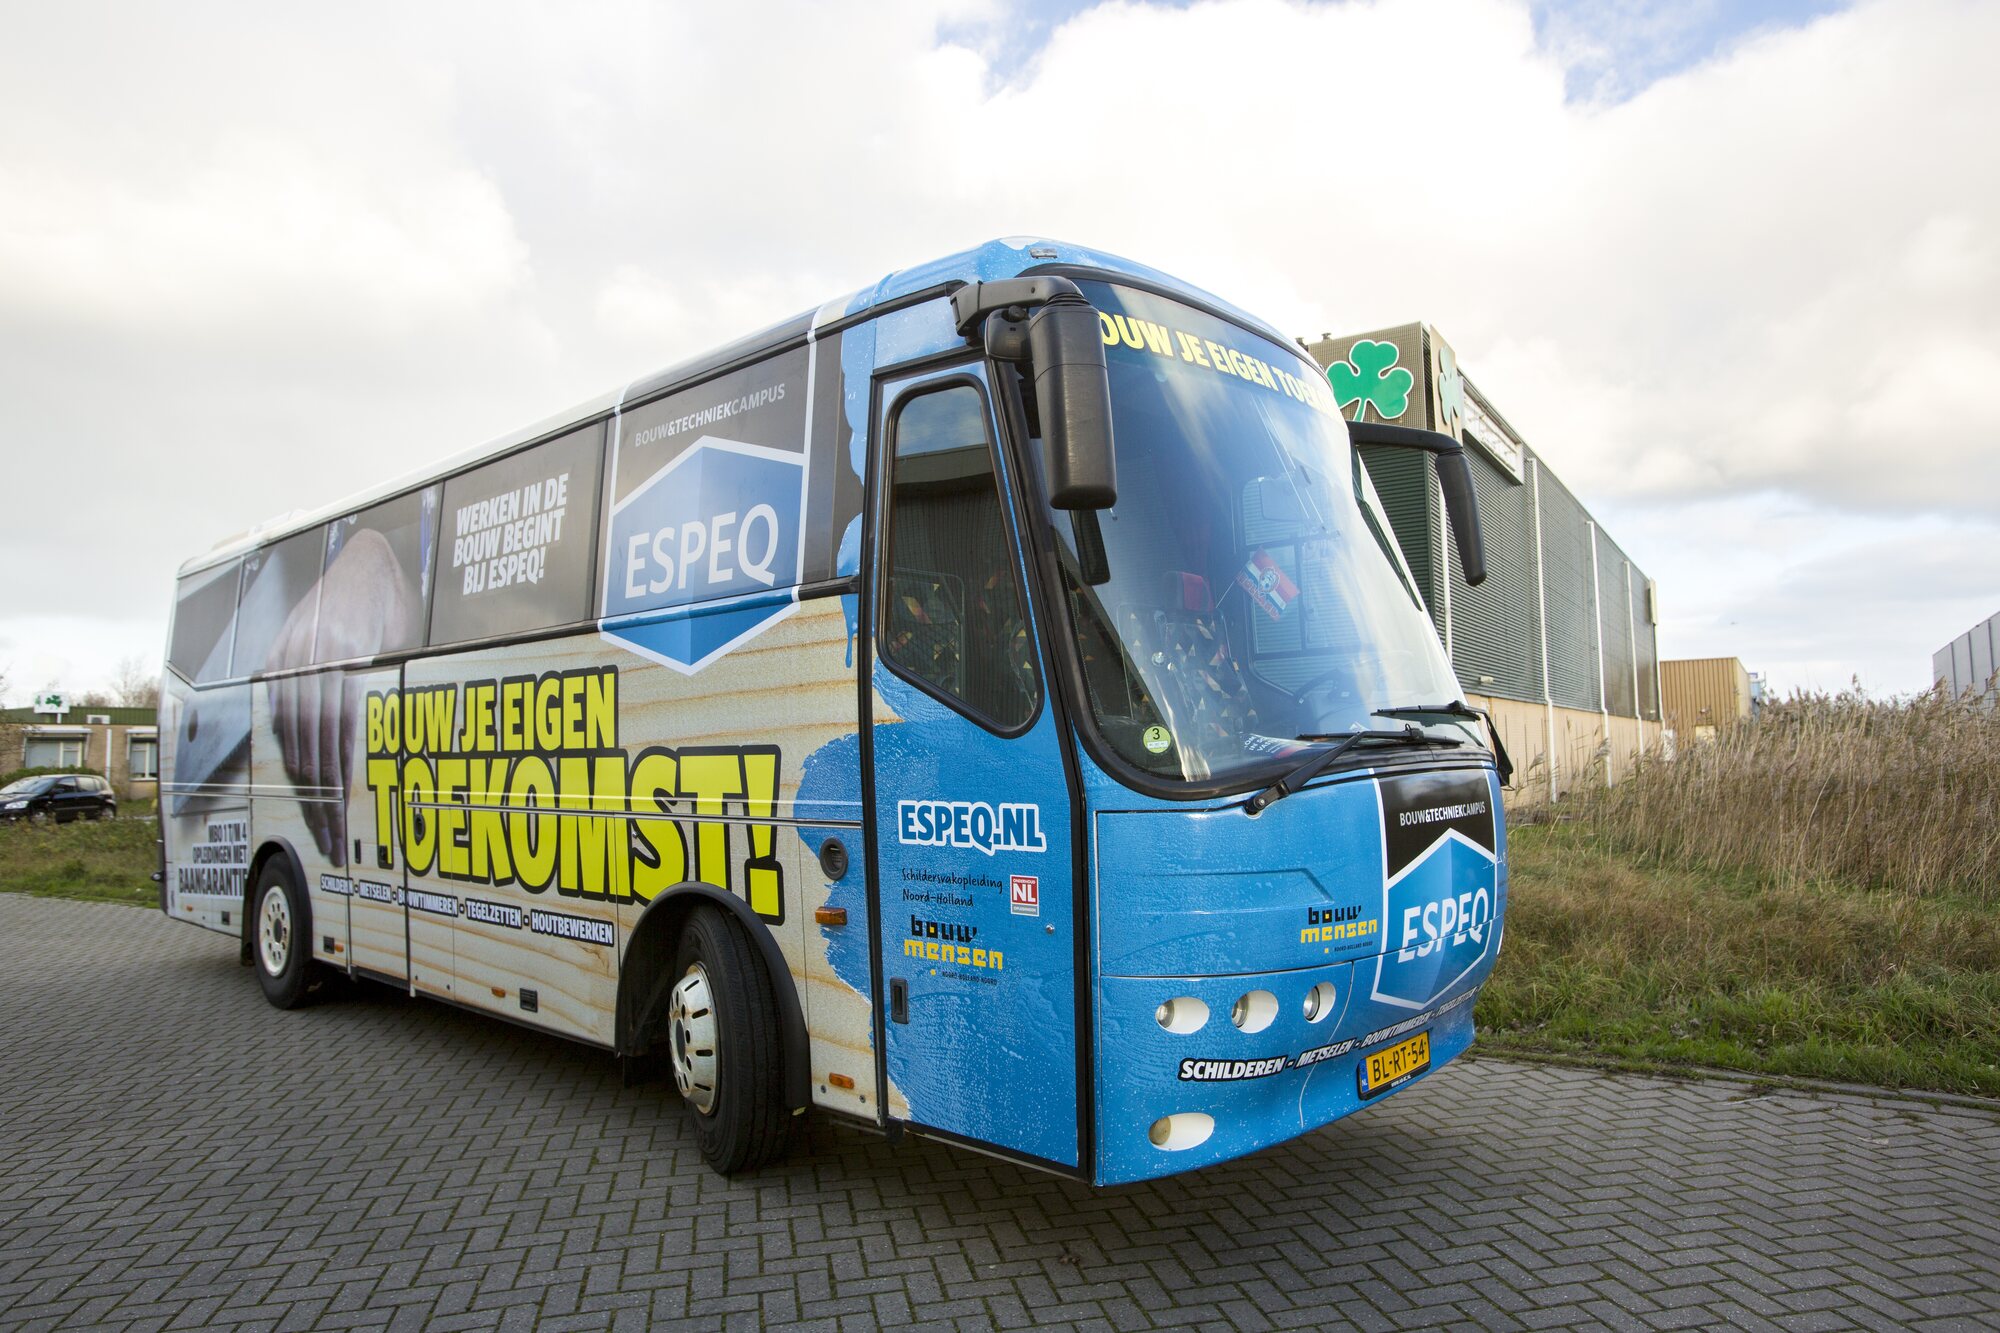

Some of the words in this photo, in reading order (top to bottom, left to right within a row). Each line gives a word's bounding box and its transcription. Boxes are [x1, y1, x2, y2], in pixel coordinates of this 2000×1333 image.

[1100, 311, 1173, 357] OUW
[1175, 330, 1210, 367] JE
[1206, 344, 1279, 392] EIGEN
[635, 383, 785, 447] BOUW&TECHNIEKCAMPUS
[456, 489, 520, 537] WERKEN
[522, 482, 542, 517] IN
[544, 473, 569, 510] DE
[453, 526, 502, 567] BOUW
[503, 508, 565, 555] BEGINT
[625, 503, 779, 599] ESPEQ
[463, 562, 486, 595] BIJ
[488, 546, 546, 590] ESPEQ!
[367, 687, 456, 755] BOUW
[460, 684, 496, 753] JE
[502, 672, 616, 751] EIGEN
[1152, 727, 1160, 740] 3
[367, 751, 782, 918] TOEKOMST!
[899, 803, 1045, 853] ESPEQ.NL
[1400, 801, 1486, 827] BOUW&TECHNIEKCAMPUS
[901, 867, 1003, 894] Schildersvakopleiding
[902, 888, 974, 907] Noord-Holland
[1013, 883, 1036, 903] NL
[359, 881, 391, 903] METSELEN
[466, 900, 521, 928] TEGELZETTEN
[531, 911, 613, 944] HOUTBEWERKEN
[911, 914, 977, 943] bouw
[1301, 919, 1377, 943] mensen
[1308, 905, 1362, 925] bouw
[1397, 887, 1488, 963] ESPEQ
[904, 939, 1003, 971] mensen
[1180, 1057, 1287, 1079] SCHILDEREN
[1297, 1039, 1356, 1067] METSELEN
[1361, 1010, 1433, 1048] BOUWTIMMEREN
[1372, 1039, 1425, 1083] BL-RT-54
